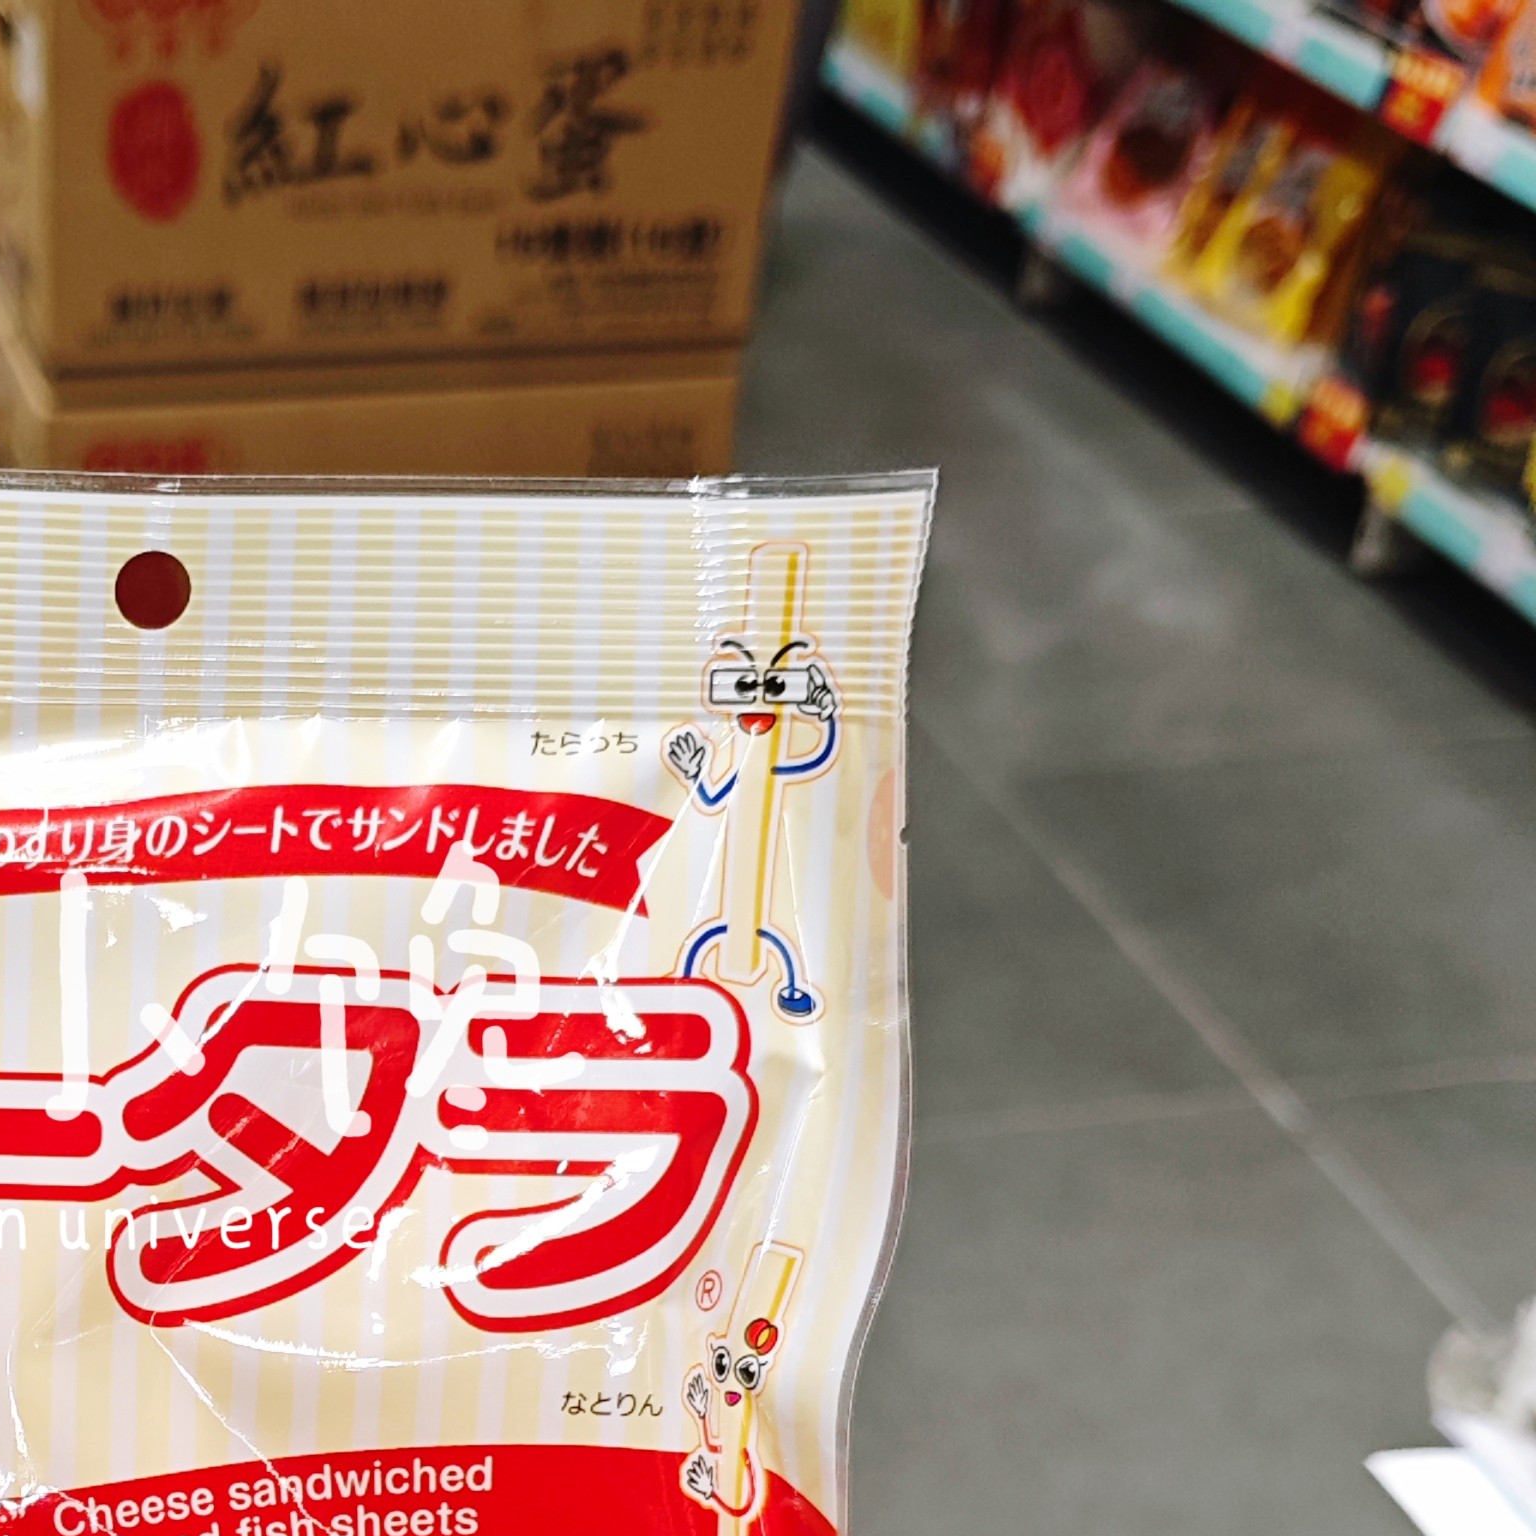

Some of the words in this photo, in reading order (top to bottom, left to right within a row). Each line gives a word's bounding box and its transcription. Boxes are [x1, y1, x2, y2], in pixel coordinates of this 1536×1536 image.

[221, 46, 657, 207] 紅心蛋
[561, 1391, 664, 1417] なとりん
[53, 1488, 214, 1536] Cheese
[228, 1456, 493, 1511] sandwiched
